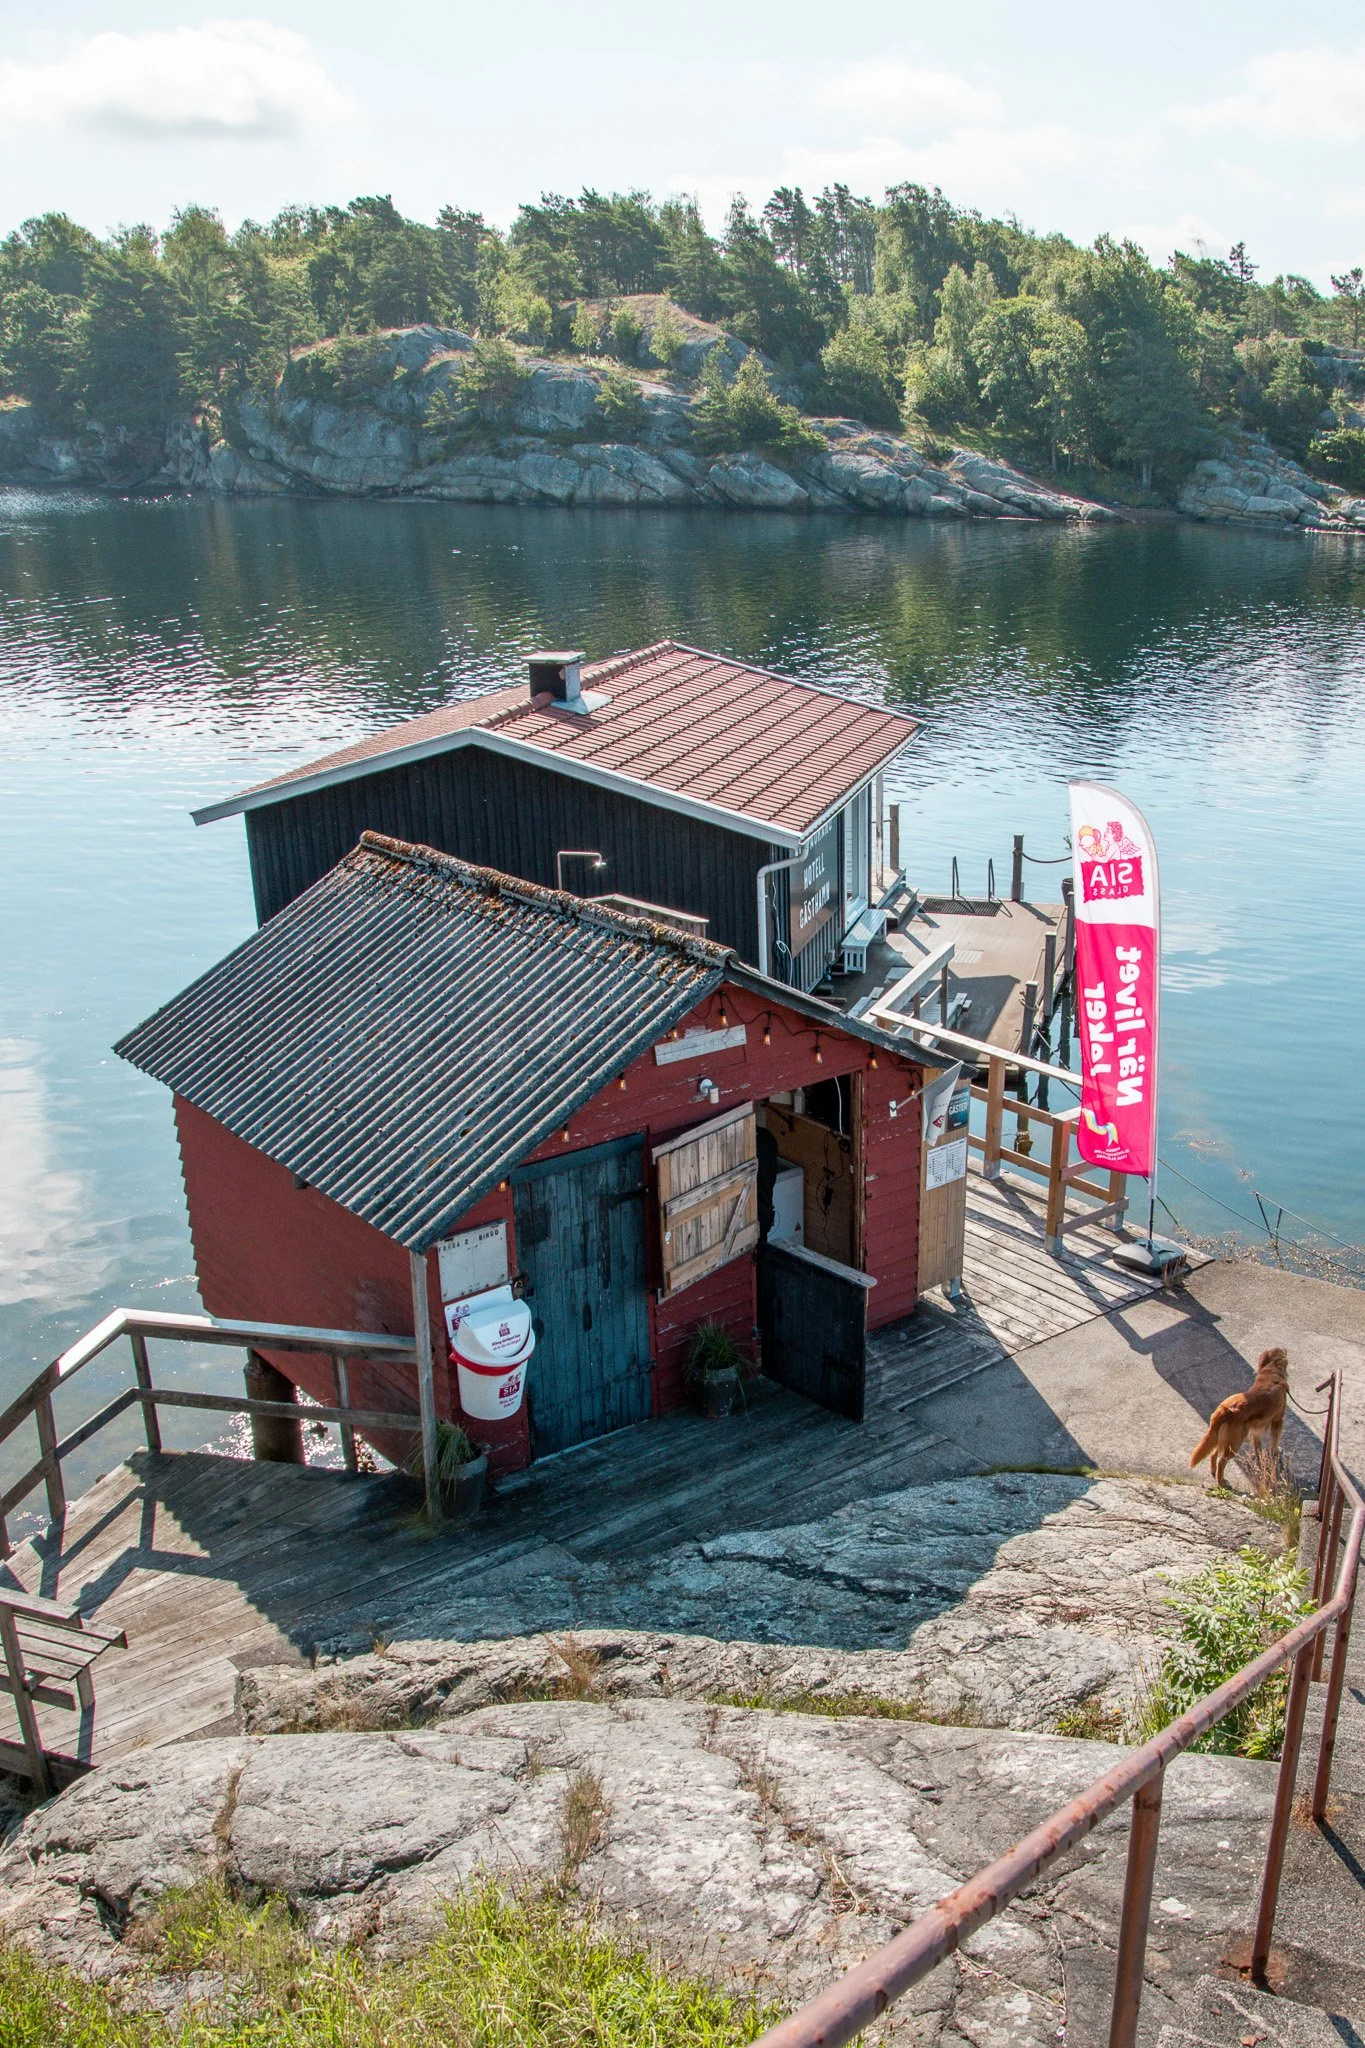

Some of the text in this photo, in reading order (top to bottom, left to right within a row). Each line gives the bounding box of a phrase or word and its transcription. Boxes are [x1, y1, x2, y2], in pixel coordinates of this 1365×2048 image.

[804, 852, 825, 890] HOTELL
[799, 880, 830, 929] GÄSTHAMN
[503, 1385, 518, 1395] SIA
